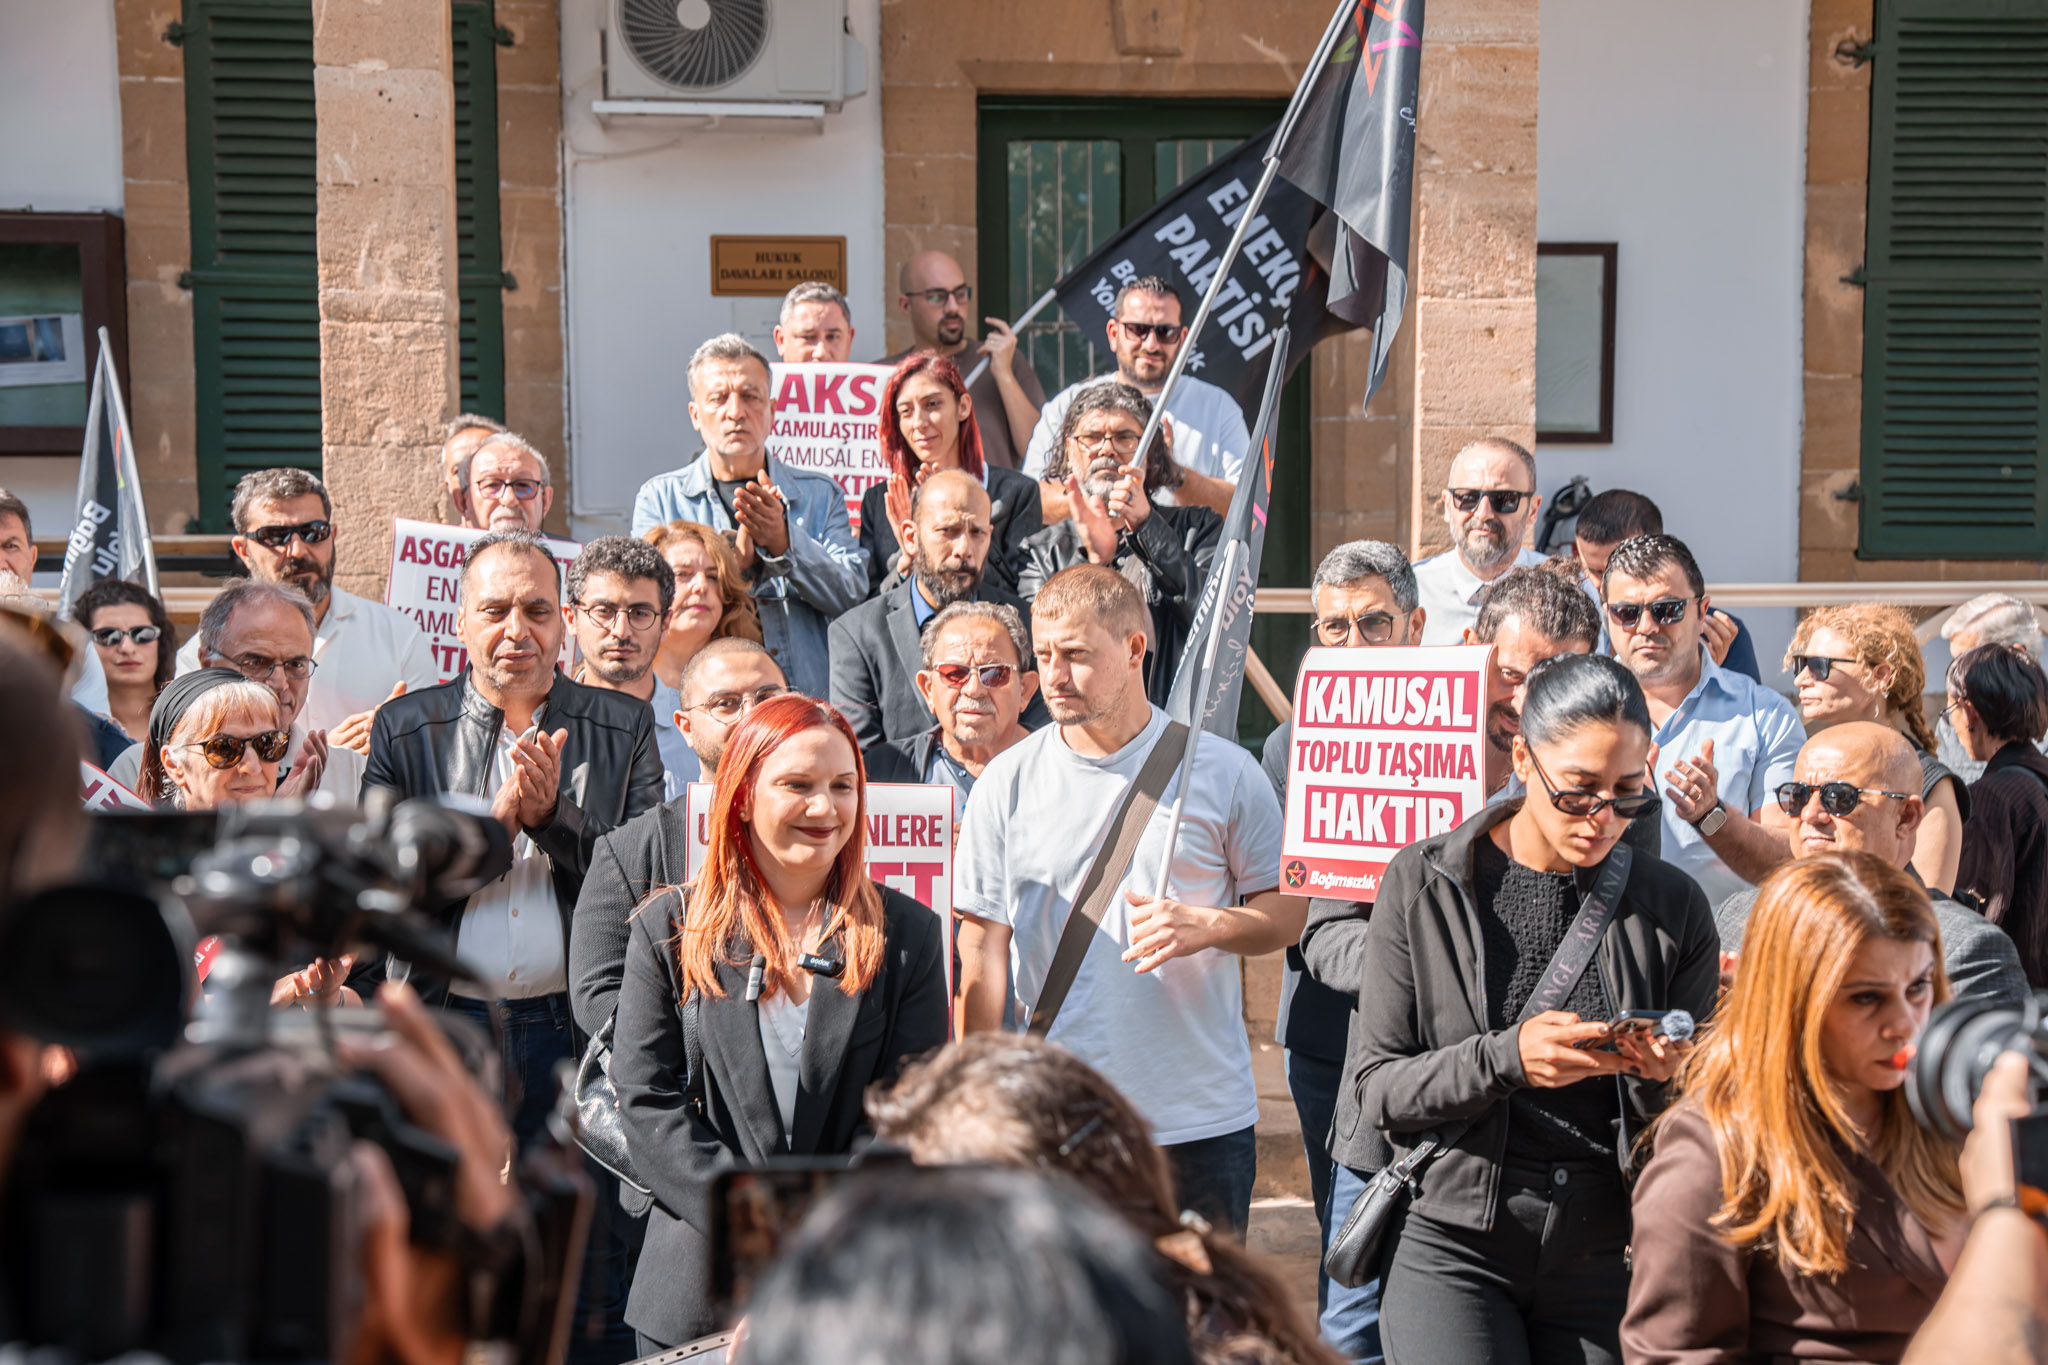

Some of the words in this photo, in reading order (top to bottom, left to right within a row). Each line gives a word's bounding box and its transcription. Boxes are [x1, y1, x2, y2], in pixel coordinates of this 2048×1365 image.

[720, 268, 783, 280] DAVALARI
[786, 268, 837, 280] SALONU
[755, 252, 802, 264] HUKUK
[775, 374, 882, 416] AKS
[770, 419, 879, 444] KAMULAŞTIR
[772, 445, 855, 468] KAMUSAL
[399, 536, 465, 569] ASGA
[1305, 676, 1473, 727] KAMUSAL
[1297, 740, 1372, 775] TOPLU
[1377, 742, 1477, 787] TAŞIMA
[1310, 791, 1455, 844] HAKTIR
[1309, 869, 1377, 890] Bağımsızlık
[1577, 872, 1620, 945] ARMANI
